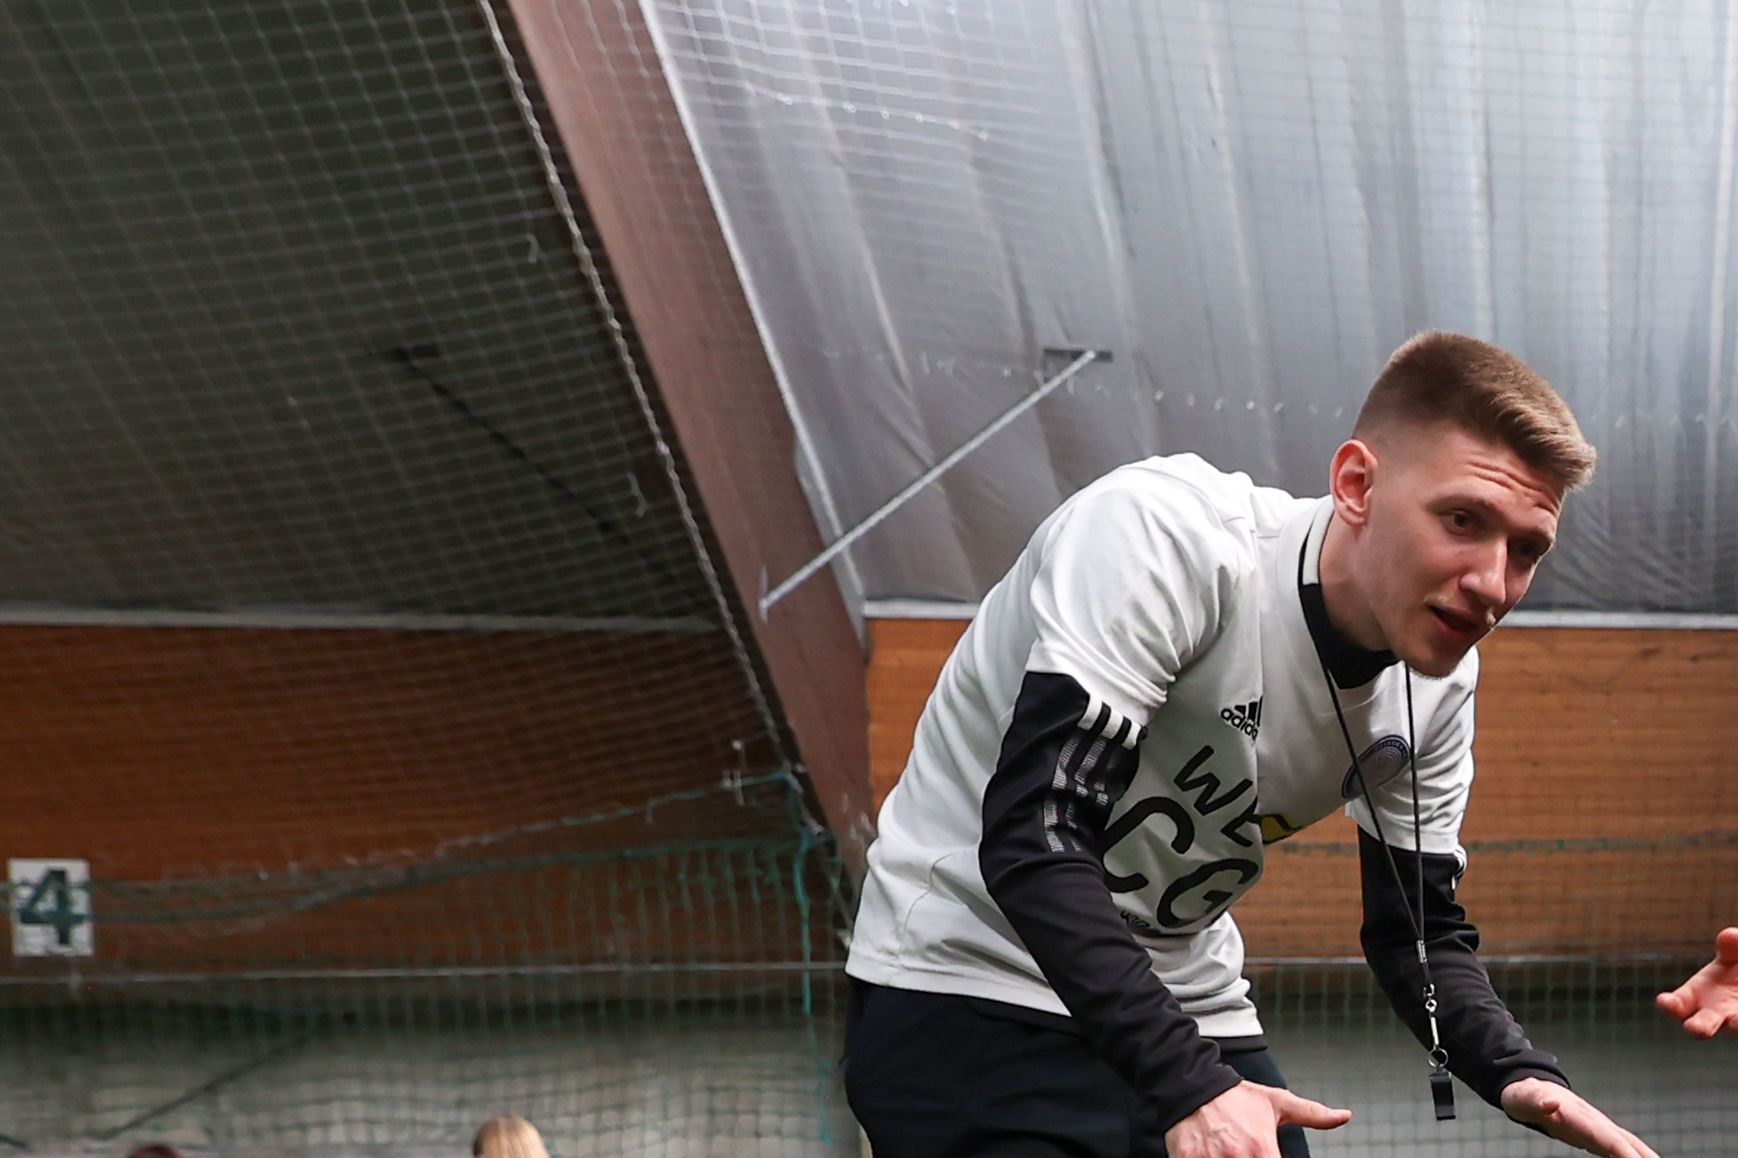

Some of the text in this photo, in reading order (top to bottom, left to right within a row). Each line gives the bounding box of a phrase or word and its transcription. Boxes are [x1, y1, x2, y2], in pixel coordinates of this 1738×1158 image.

[1220, 708, 1259, 741] adida
[1100, 796, 1260, 929] CG
[20, 869, 84, 946] 4
